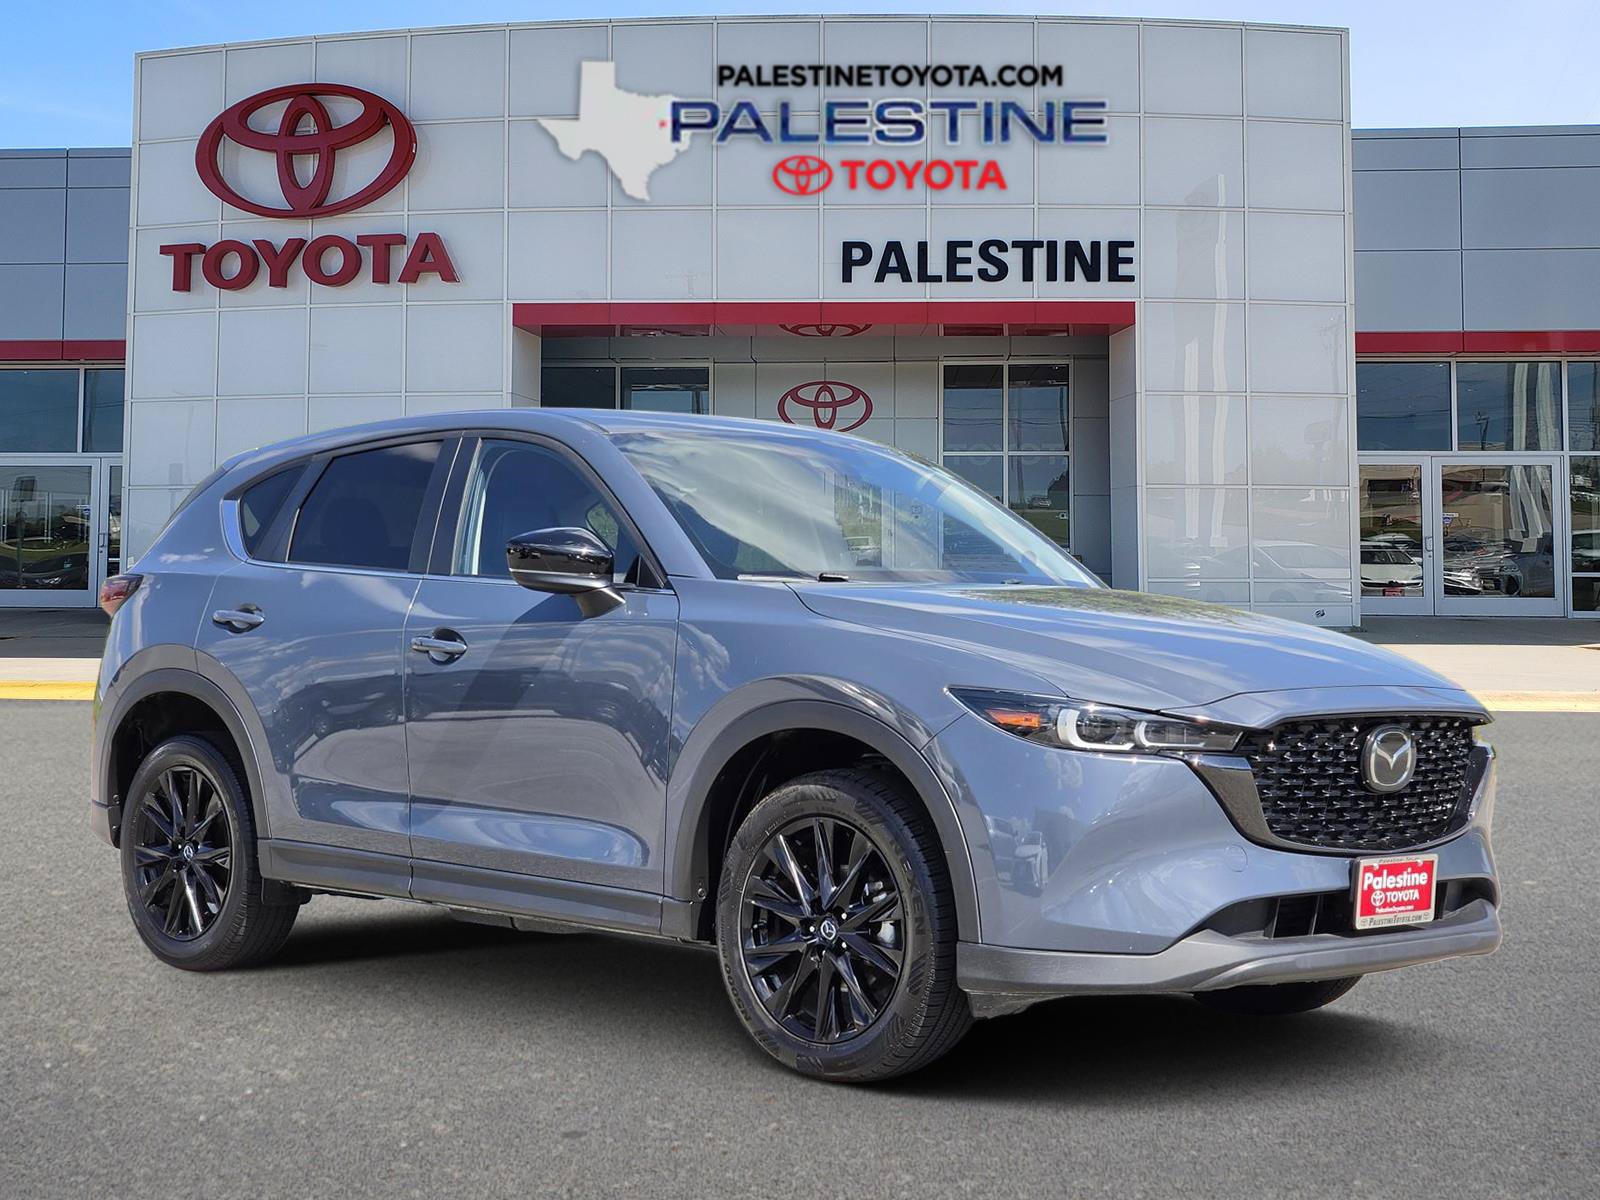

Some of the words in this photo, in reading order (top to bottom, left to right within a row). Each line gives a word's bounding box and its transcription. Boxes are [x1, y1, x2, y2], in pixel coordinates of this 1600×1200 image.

[160, 232, 460, 292] TOYOTA
[842, 240, 1135, 283] PALESTINE
[1363, 868, 1428, 890] Palestine
[1386, 890, 1419, 903] TOYOTA
